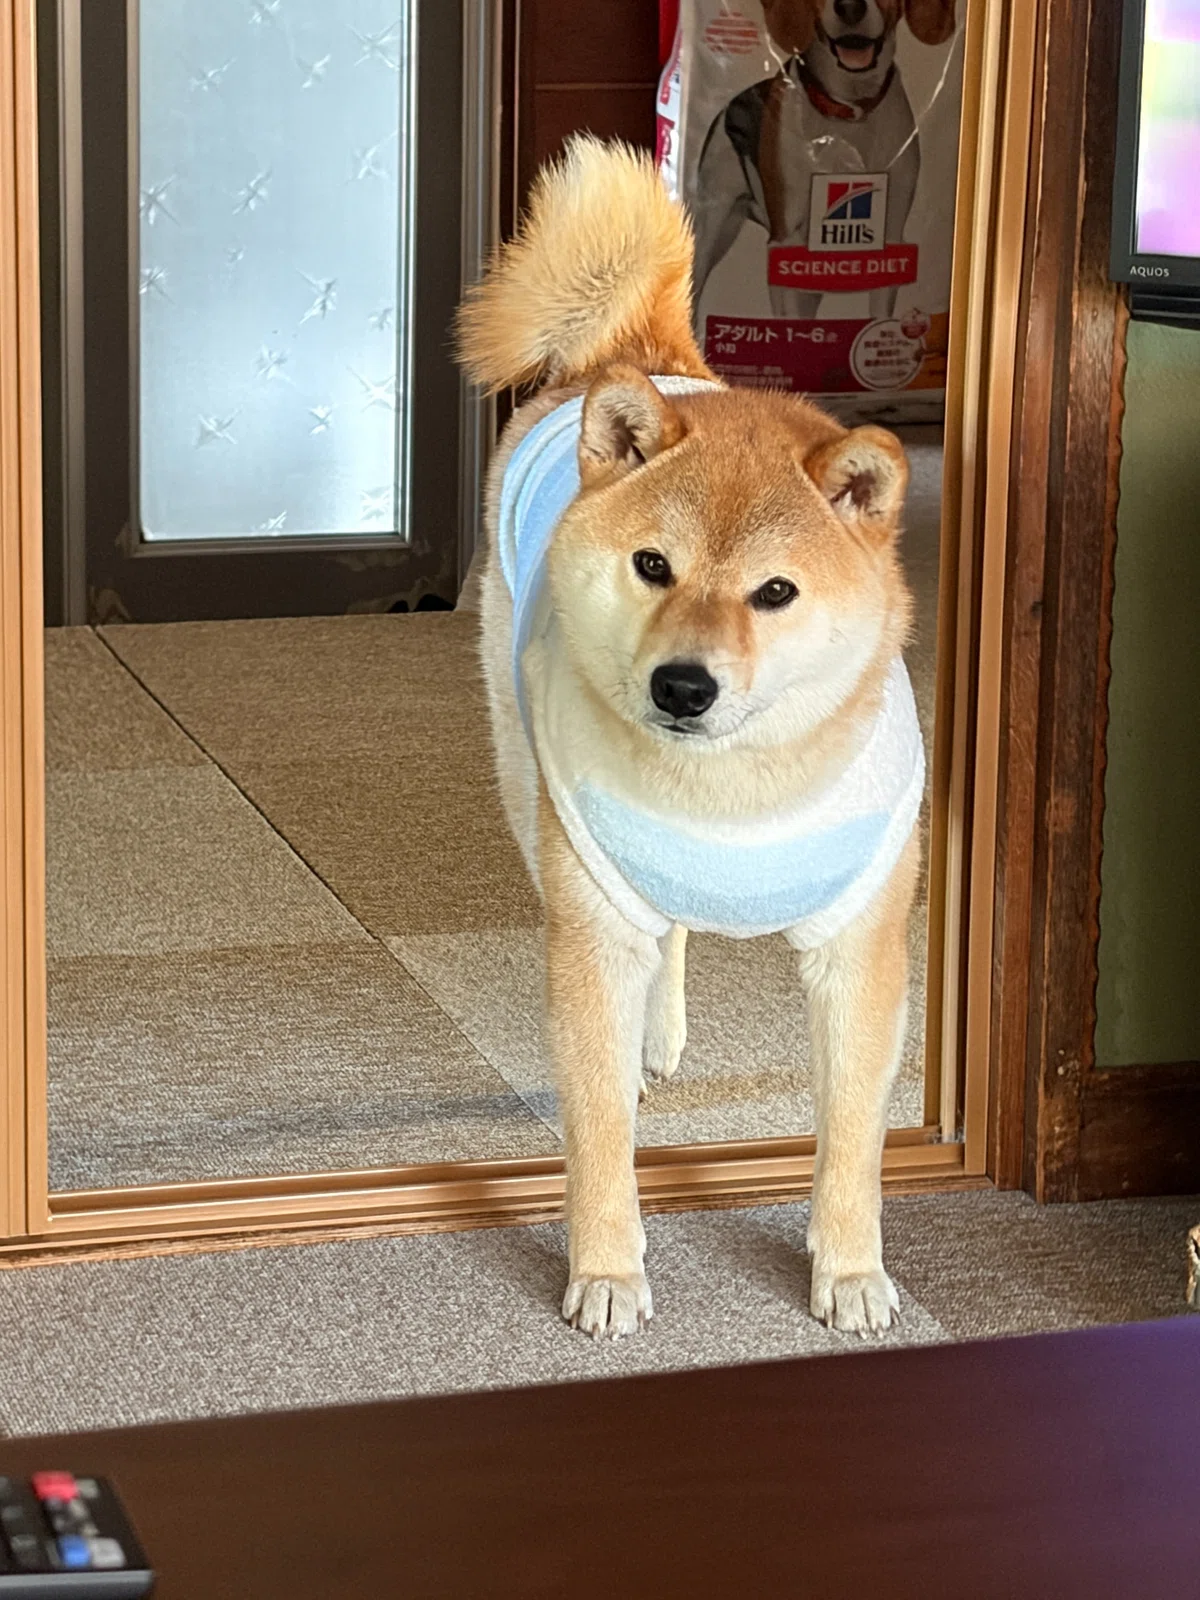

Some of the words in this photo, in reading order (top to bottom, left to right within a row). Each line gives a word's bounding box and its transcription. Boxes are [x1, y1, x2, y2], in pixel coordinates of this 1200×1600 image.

[820, 223, 875, 244] Hill's
[778, 259, 862, 276] SCIENCE
[866, 257, 909, 274] DIET
[1129, 265, 1170, 277] AQUOS
[714, 323, 779, 343] アダルト
